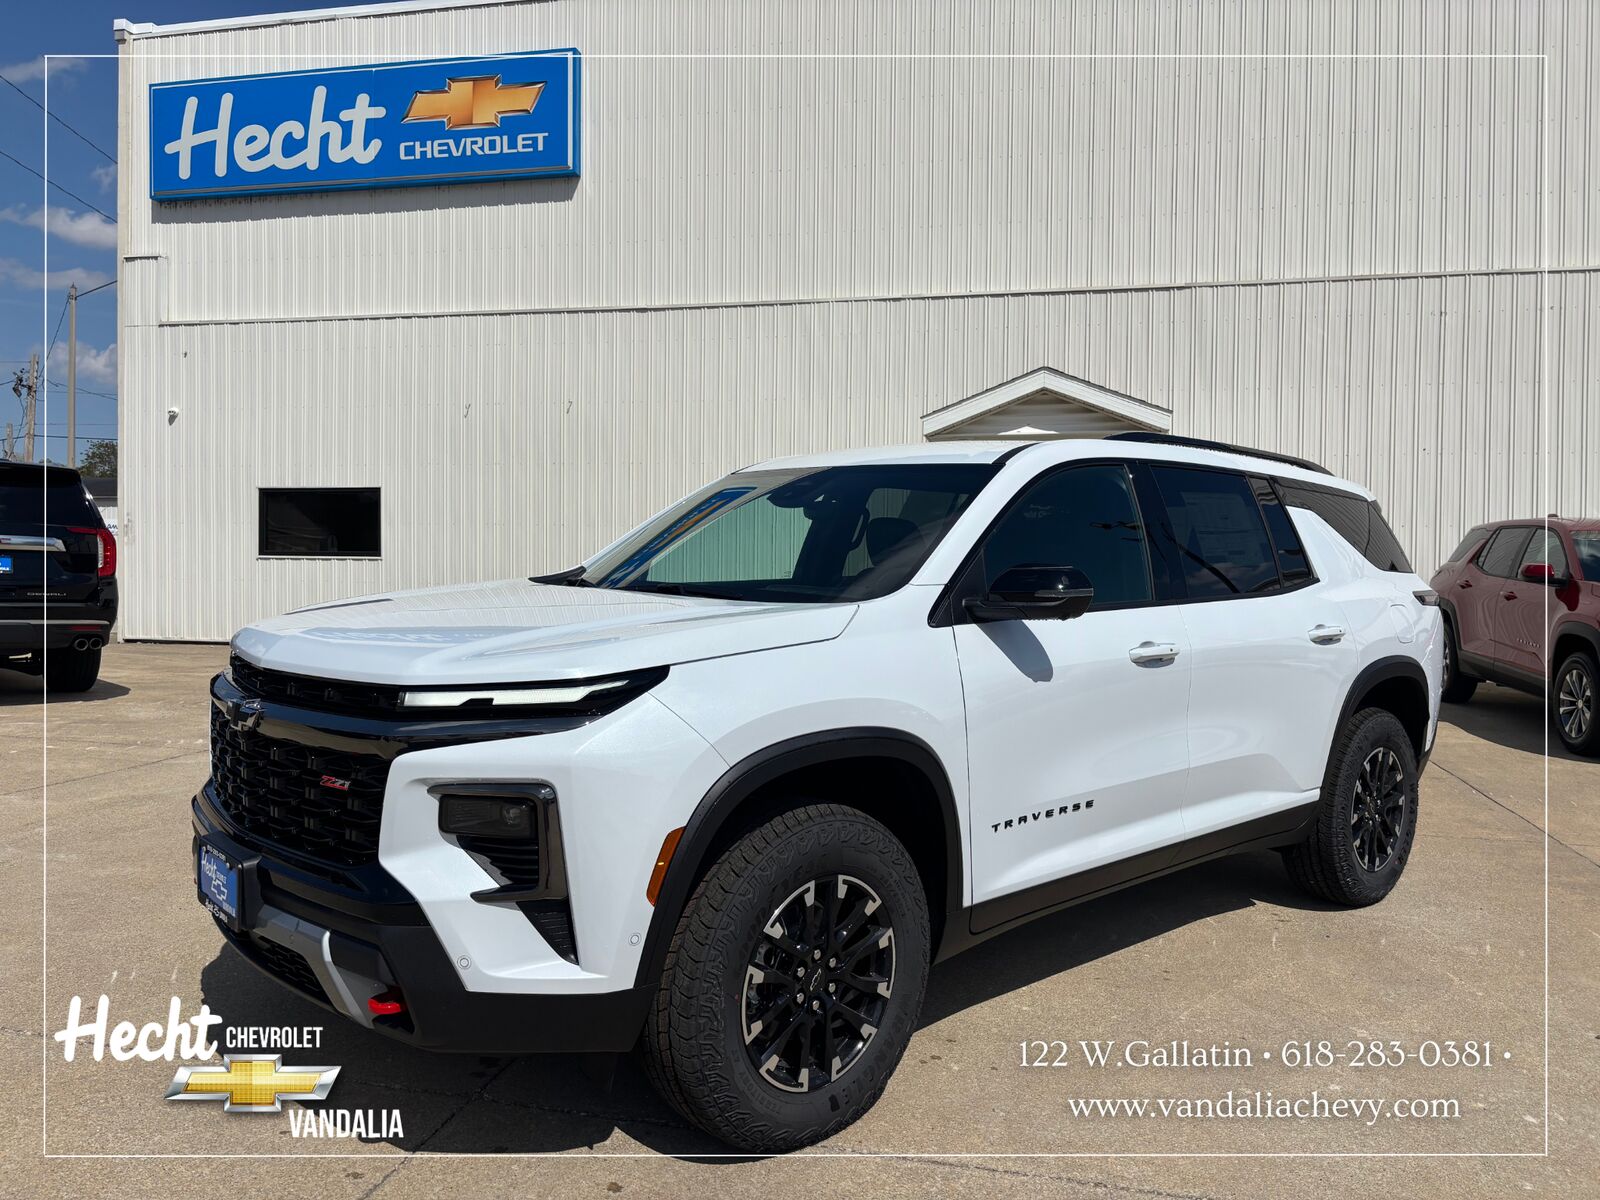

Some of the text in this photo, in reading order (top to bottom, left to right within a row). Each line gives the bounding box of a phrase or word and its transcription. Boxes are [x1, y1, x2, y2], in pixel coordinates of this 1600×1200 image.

[164, 85, 386, 180] Hecht
[399, 132, 549, 161] CHEVROLET
[991, 799, 1095, 833] TRAVERSE
